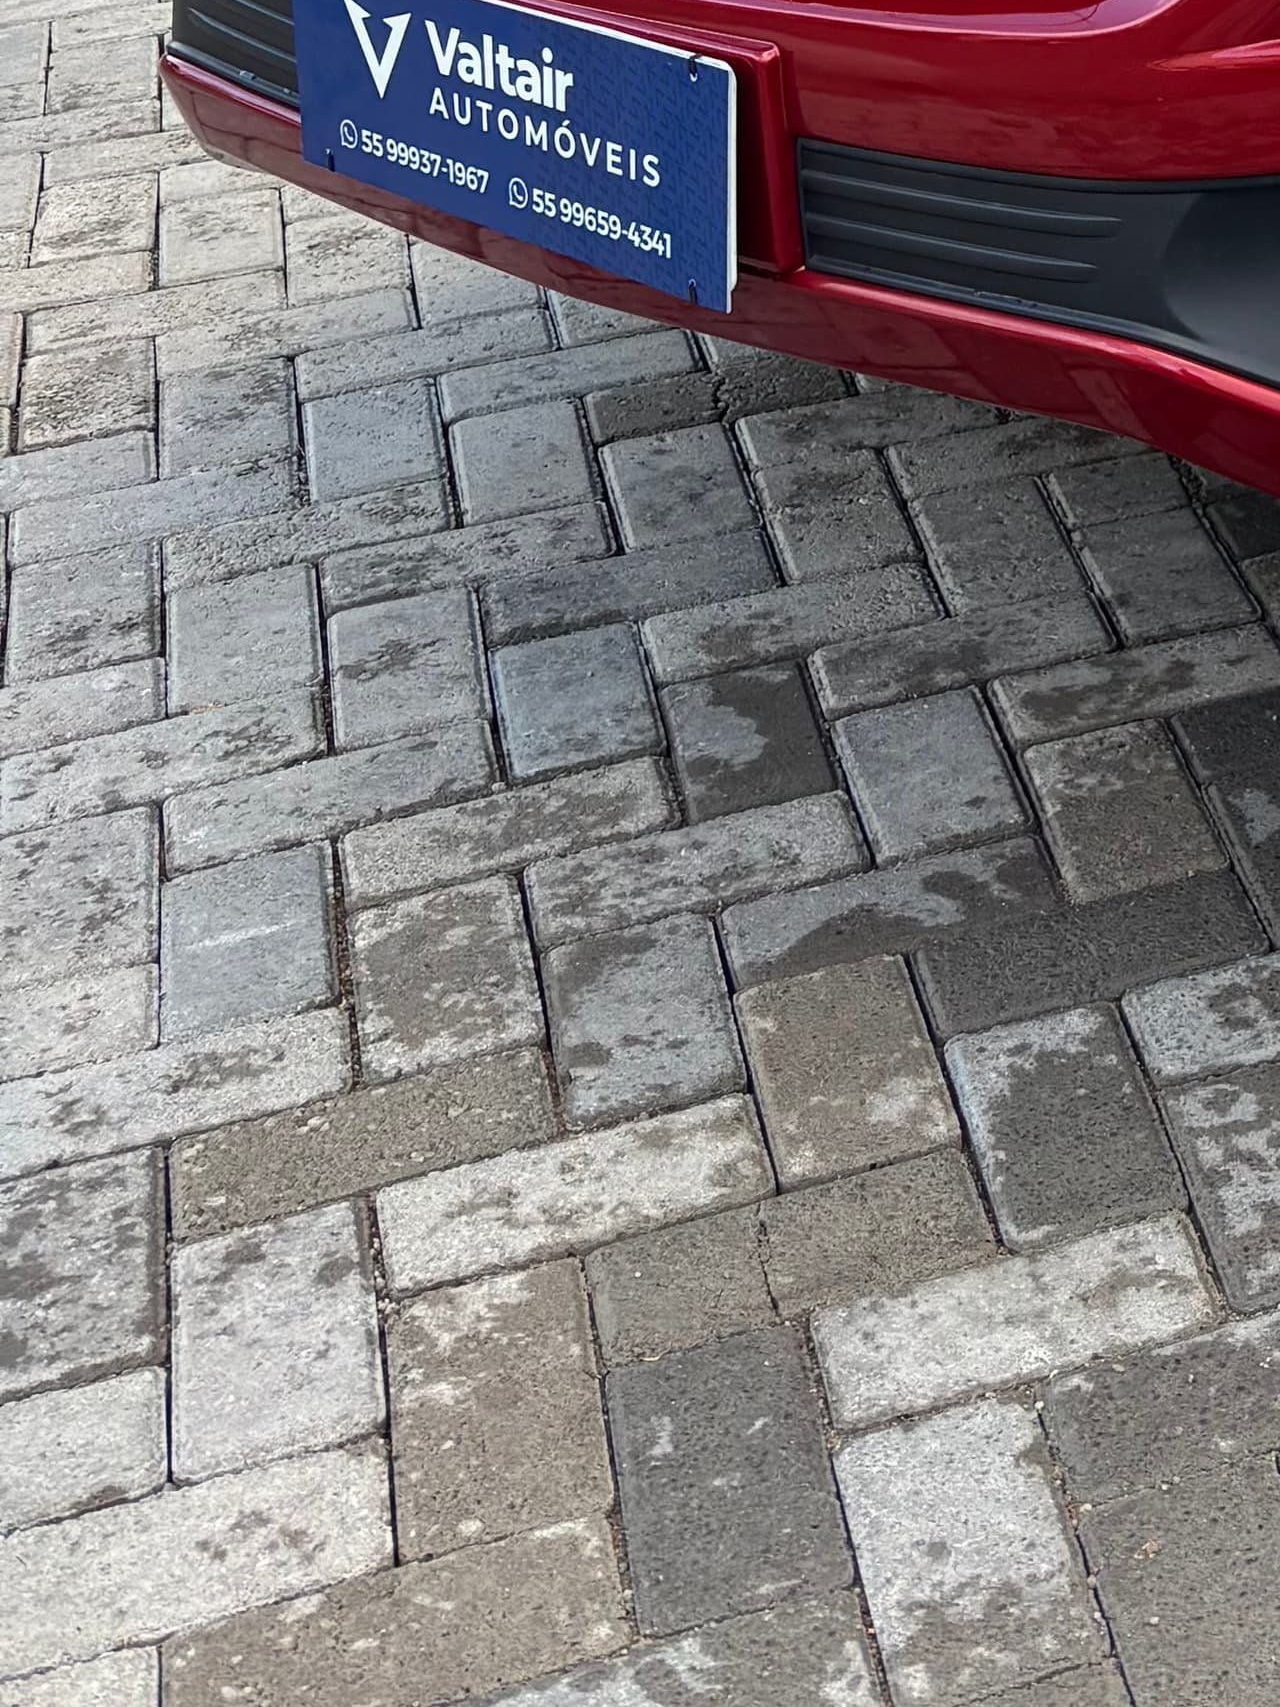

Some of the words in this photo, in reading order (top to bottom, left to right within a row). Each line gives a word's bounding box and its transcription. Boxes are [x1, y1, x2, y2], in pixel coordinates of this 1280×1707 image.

[424, 19, 573, 113] Valtair
[428, 87, 661, 189] AUTOMÓVEIS
[361, 129, 383, 155] 55
[387, 136, 489, 194] 99937-1967
[531, 187, 557, 217] 55
[559, 195, 672, 259] 99659-4341
